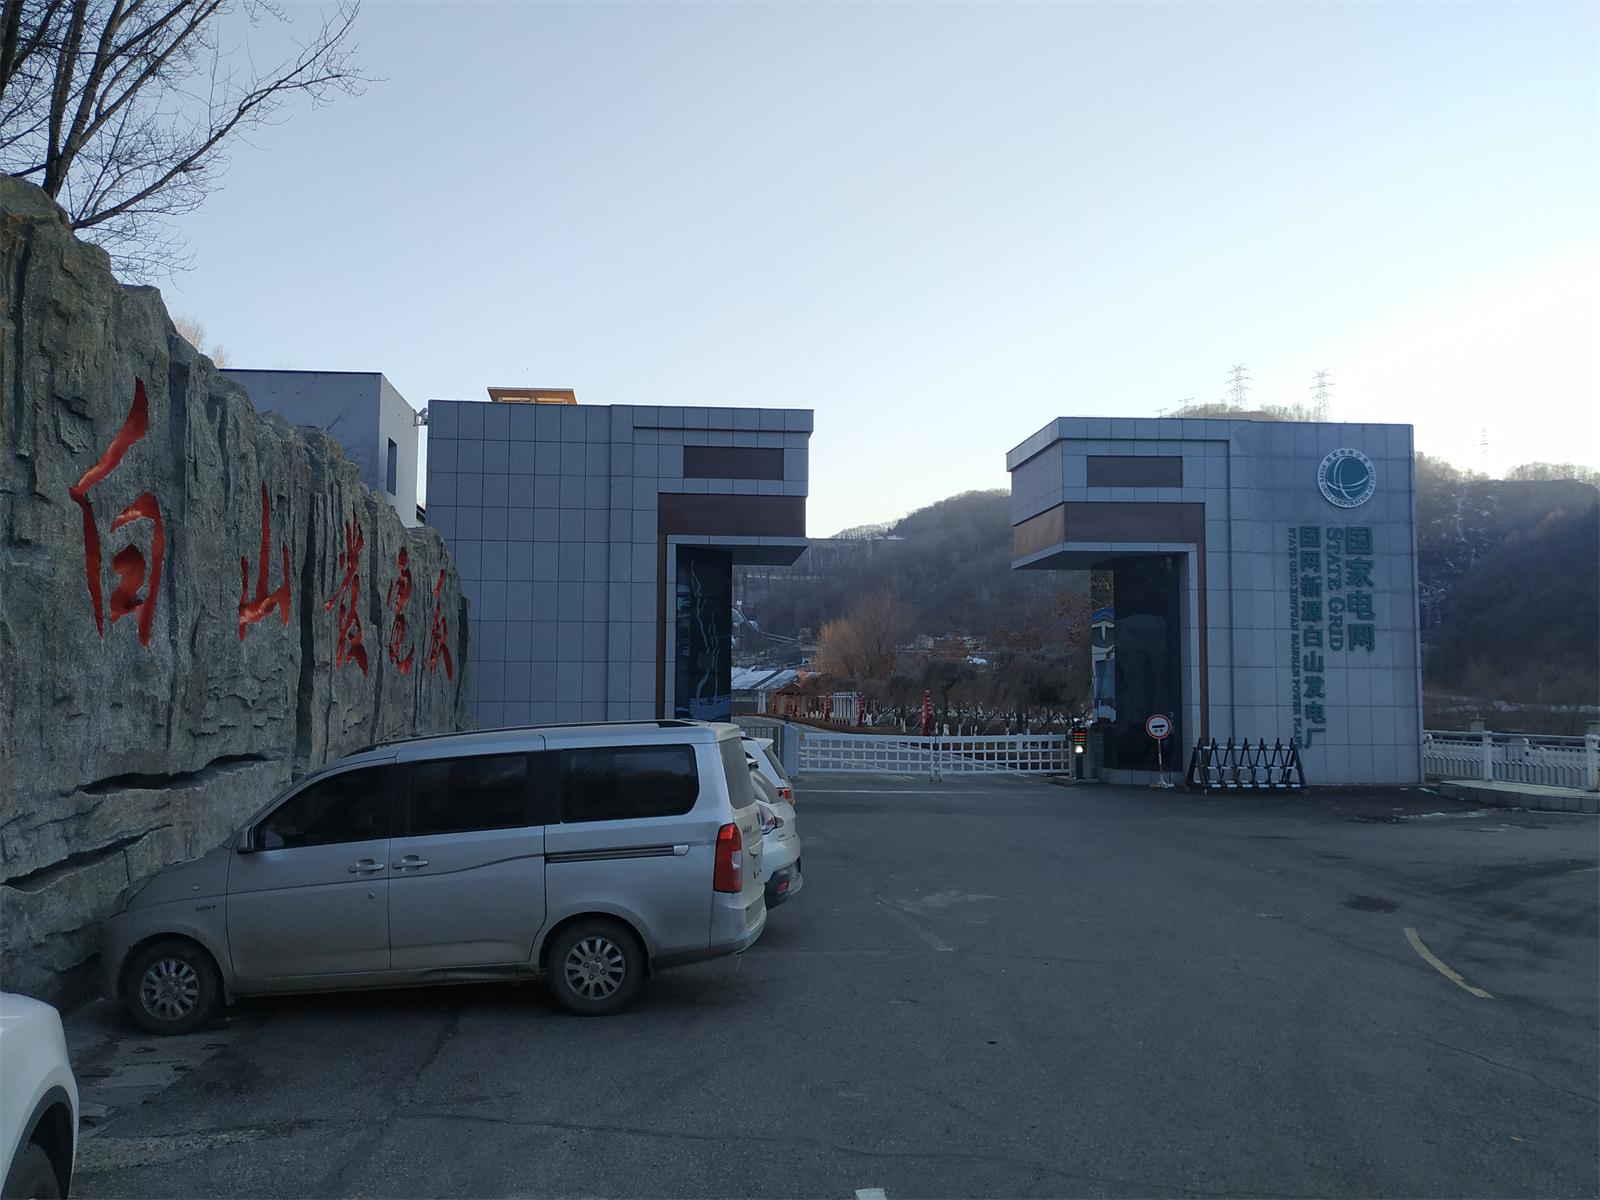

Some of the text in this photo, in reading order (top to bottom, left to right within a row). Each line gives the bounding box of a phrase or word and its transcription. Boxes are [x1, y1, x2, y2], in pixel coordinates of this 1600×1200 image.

[1299, 525, 1327, 749] 国网新源白山发电厂
[1326, 527, 1346, 652] STATE GRID
[1345, 526, 1376, 652] 国家电网
